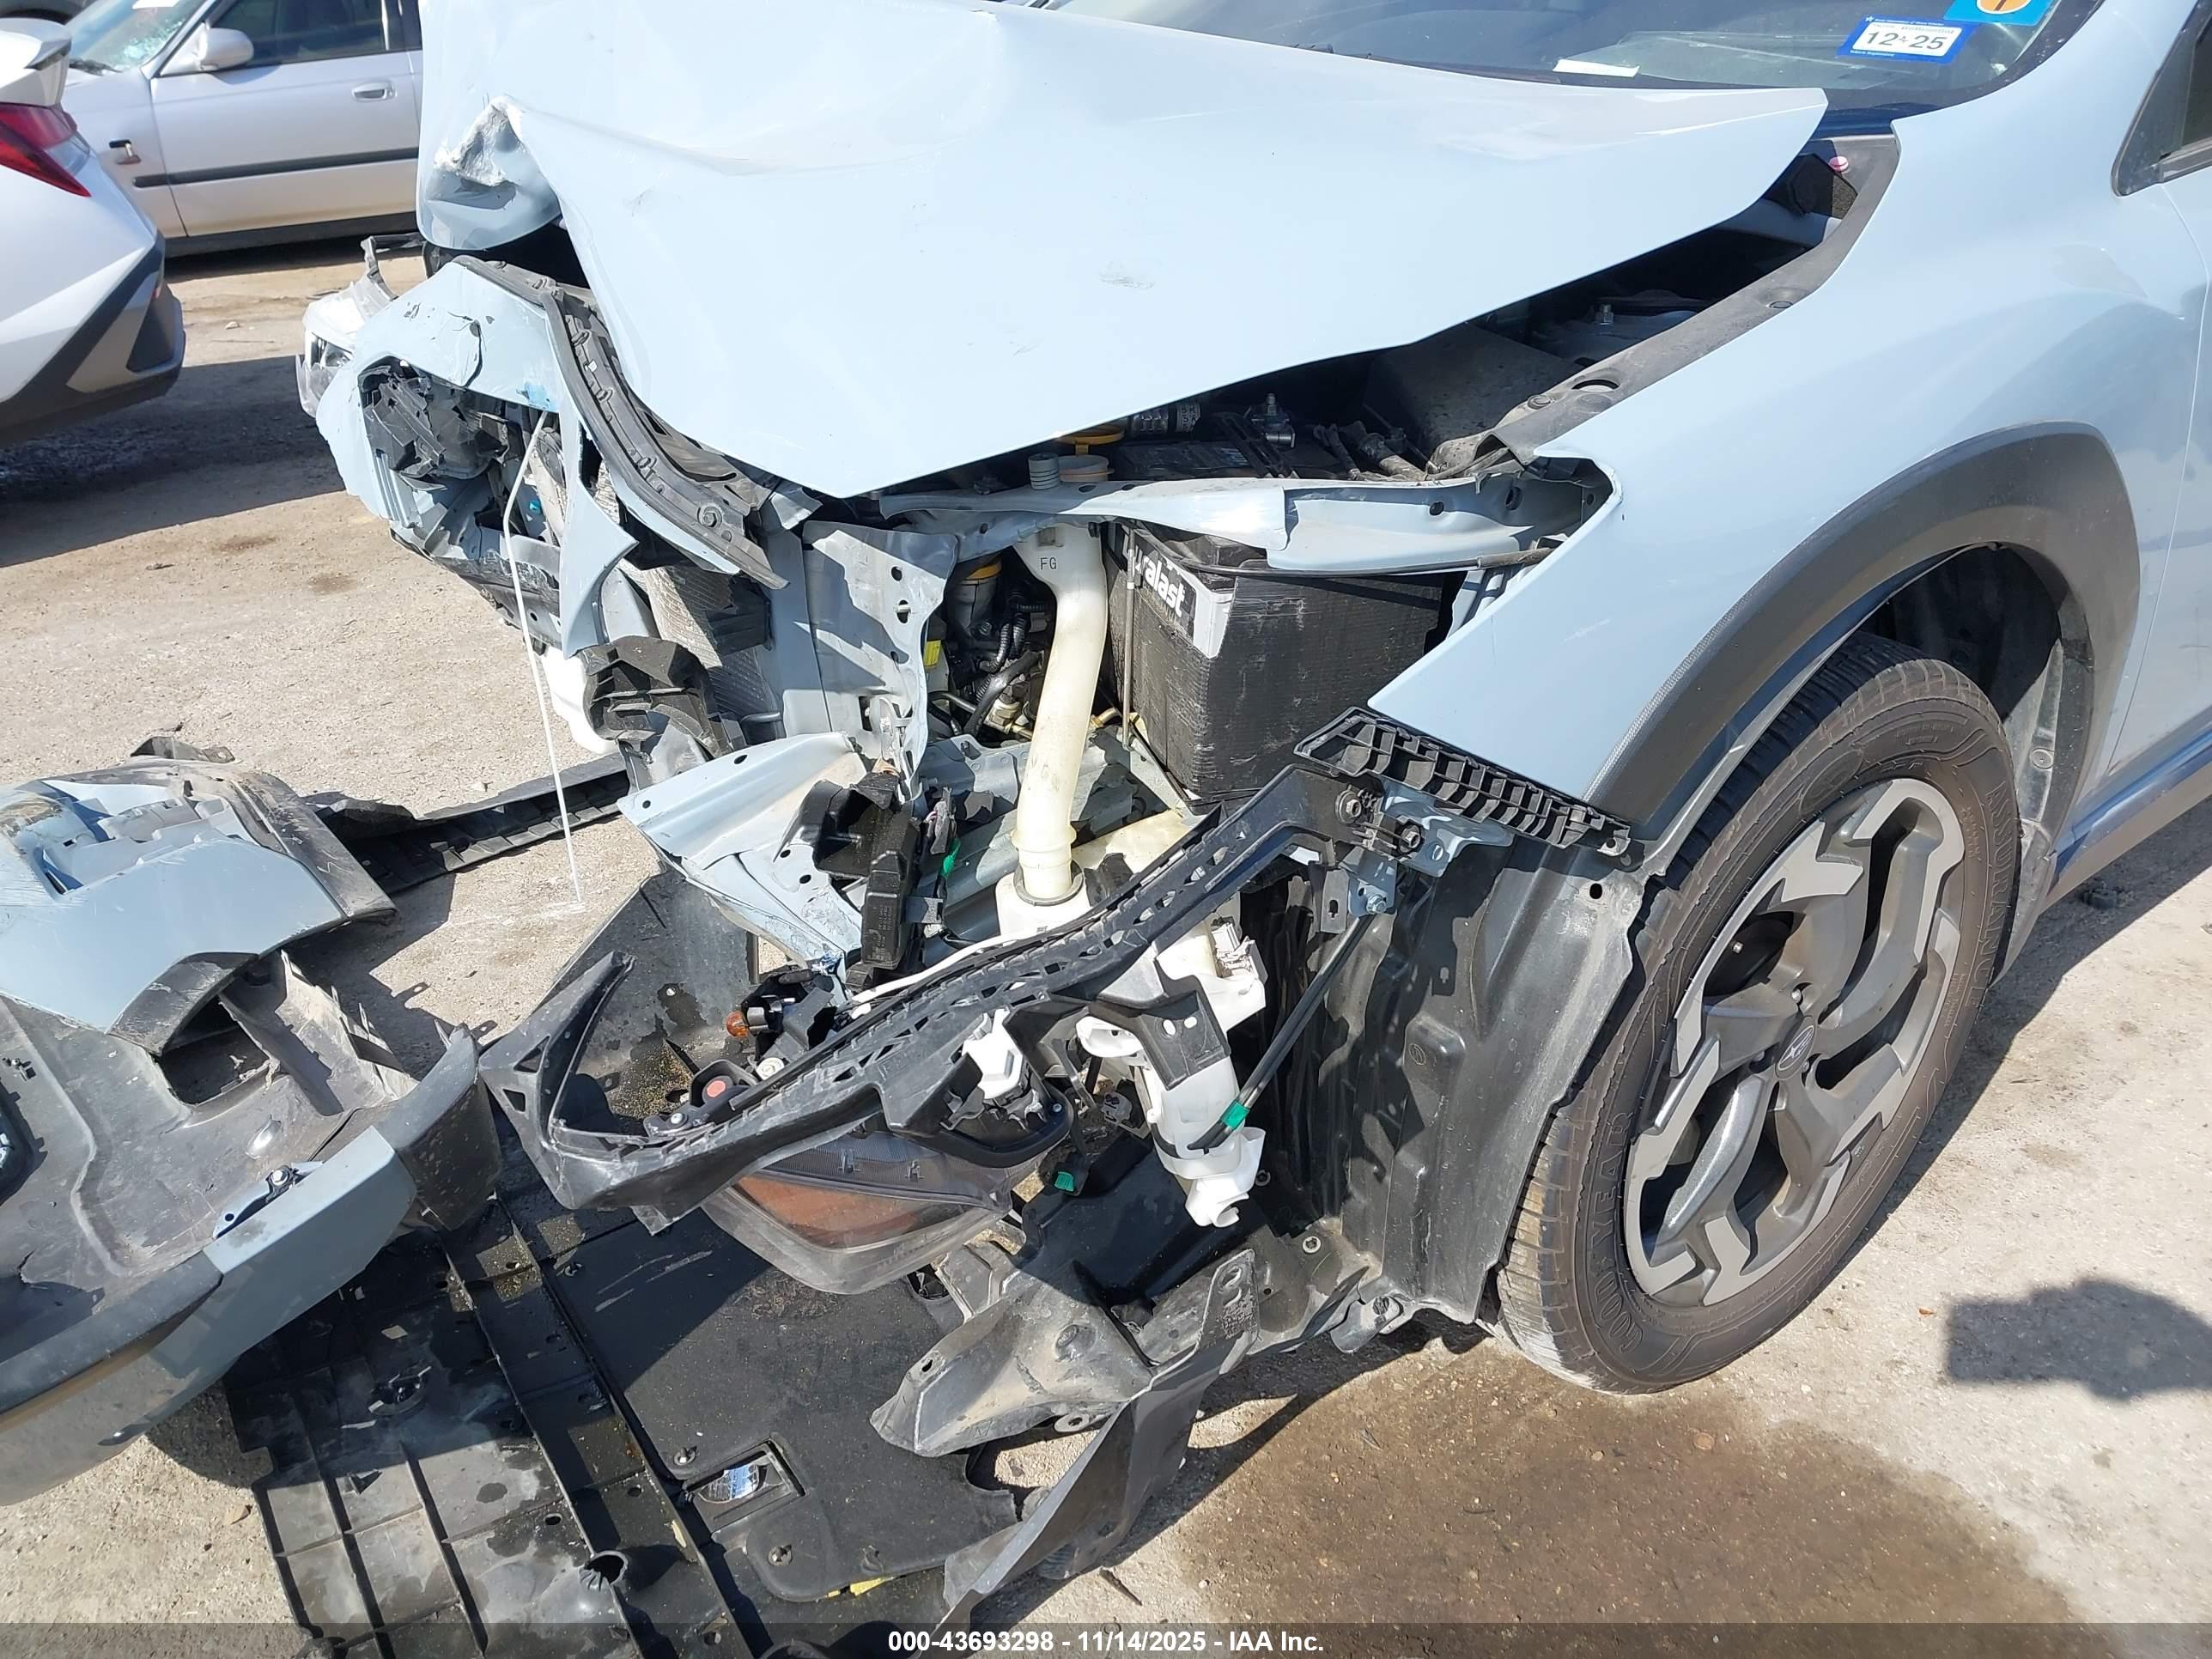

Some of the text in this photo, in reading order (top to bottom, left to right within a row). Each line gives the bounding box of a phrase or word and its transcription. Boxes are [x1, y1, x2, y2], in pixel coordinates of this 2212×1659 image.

[1865, 30, 1948, 51] 12 25
[1040, 556, 1057, 571] FG
[1964, 781, 2014, 1009] ASSURANCE
